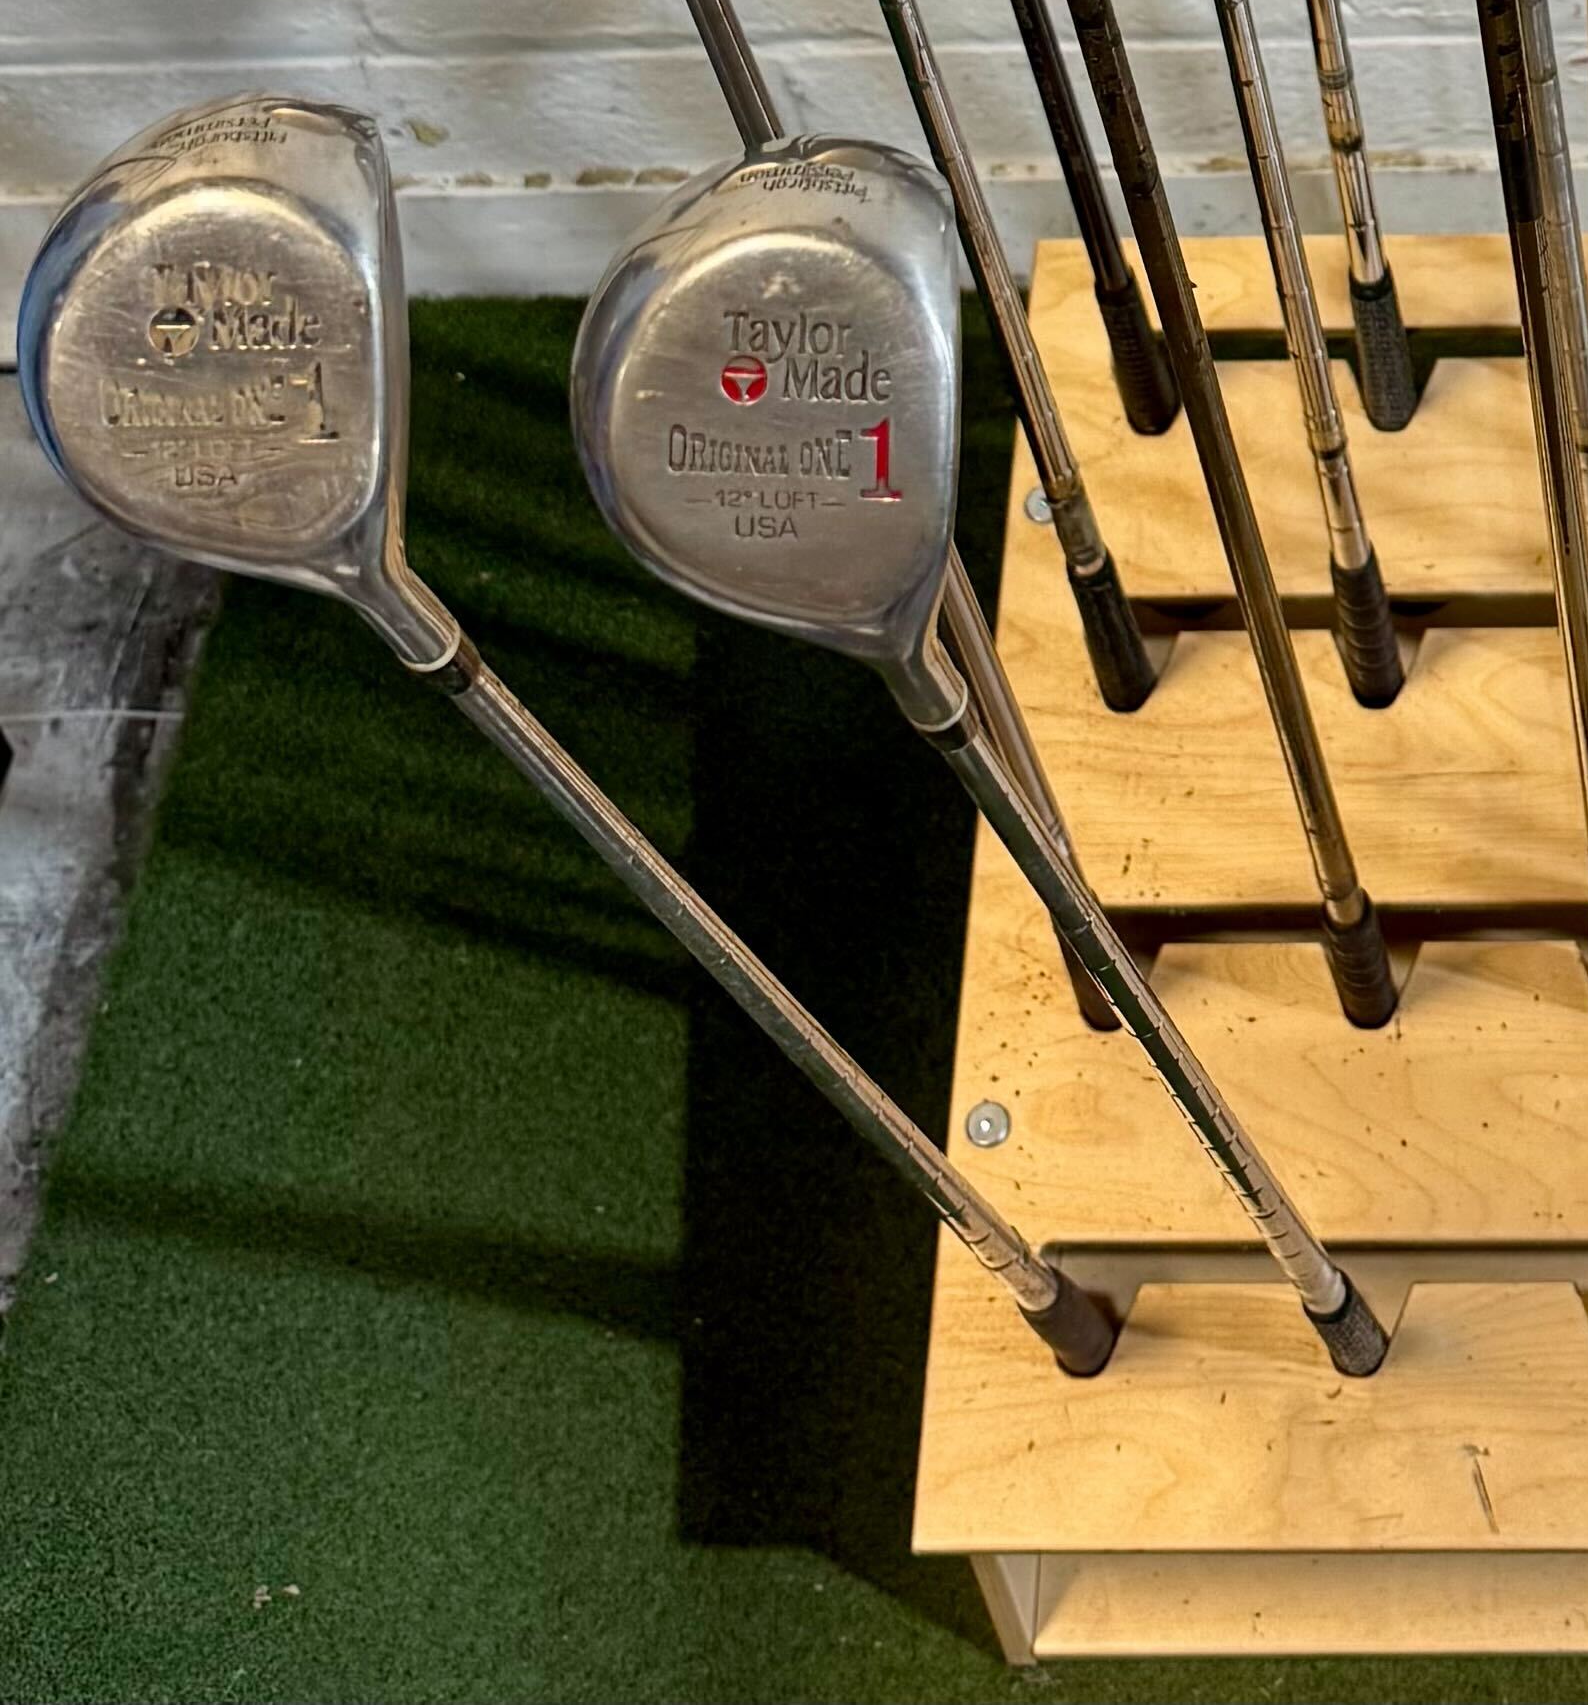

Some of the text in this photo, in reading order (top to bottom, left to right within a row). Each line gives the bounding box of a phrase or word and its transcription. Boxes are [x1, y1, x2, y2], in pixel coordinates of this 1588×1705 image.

[209, 295, 322, 350] Made
[723, 311, 852, 363] Taylor
[781, 351, 893, 403] Made
[173, 464, 239, 487] USA
[668, 417, 903, 502] ORIGINAL ONE 1
[734, 516, 799, 539] USA
